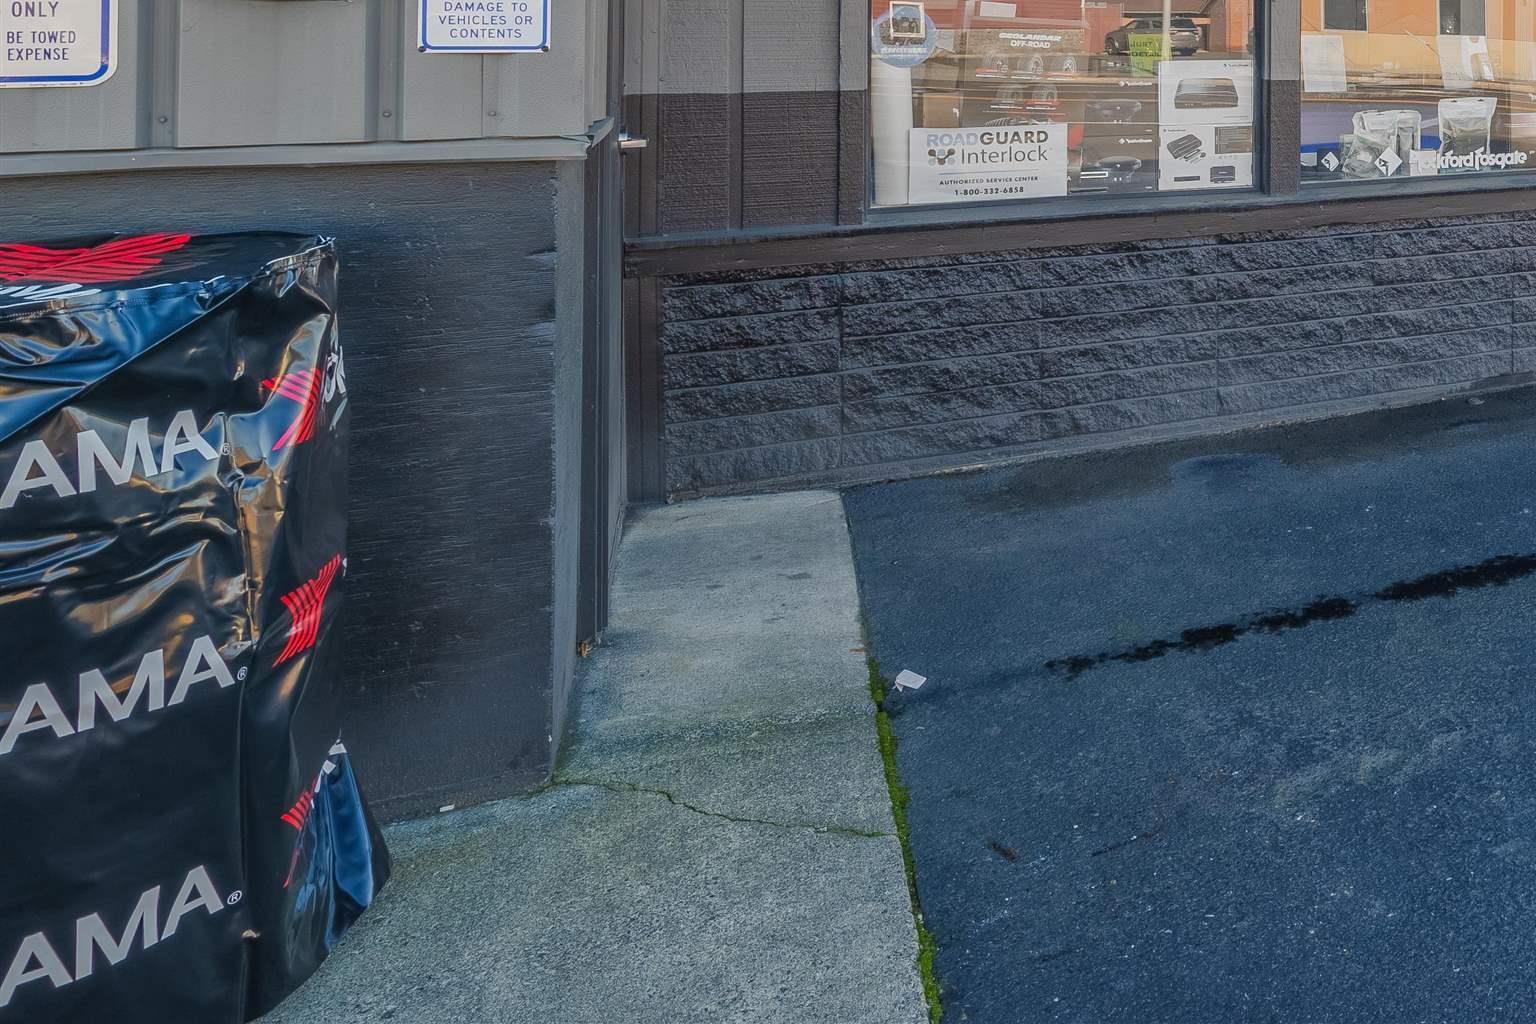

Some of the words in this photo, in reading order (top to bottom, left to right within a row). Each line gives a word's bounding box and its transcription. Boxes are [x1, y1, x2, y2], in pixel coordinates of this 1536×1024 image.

[11, 1, 60, 17] ONLY
[444, 2, 504, 12] DAMAGE
[512, 2, 528, 12] TO
[438, 15, 507, 25] VEHICLES
[515, 15, 533, 25] OR
[6, 31, 24, 44] BE
[30, 30, 76, 44] TOWED
[450, 28, 522, 39] CONTENTS
[1010, 40, 1050, 49] OFF-ROAD
[7, 48, 69, 61] EXPENSE
[926, 130, 1049, 147] ROADGUARD
[962, 145, 1048, 165] Interlock
[954, 187, 1024, 196] 1-800-332-6858
